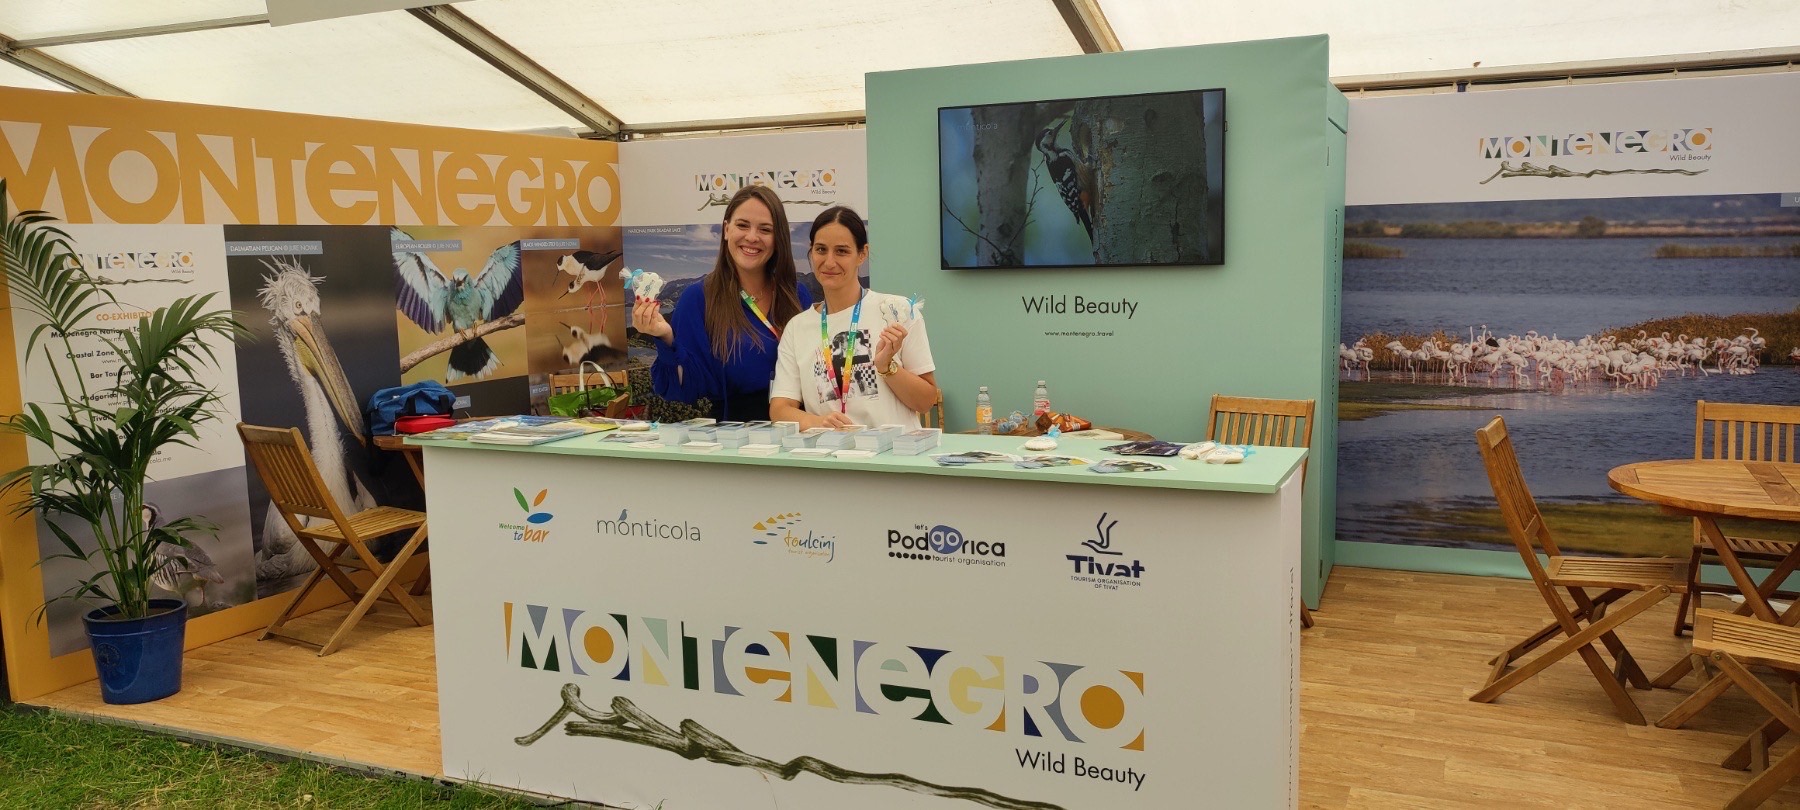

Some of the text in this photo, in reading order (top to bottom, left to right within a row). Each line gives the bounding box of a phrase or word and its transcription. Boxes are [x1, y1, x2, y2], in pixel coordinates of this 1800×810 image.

[1669, 152, 1712, 161] Wild Beauty
[1022, 294, 1139, 320] Wild Beauty
[96, 311, 155, 321] CO-EXHIBITO
[1044, 330, 1115, 338] www.montenegro.travel
[596, 518, 701, 542] monticola
[914, 523, 928, 531] let's
[513, 524, 550, 543] to bar
[932, 555, 1006, 567] tourist organisation
[1065, 554, 1146, 579] Tivat
[1070, 575, 1141, 587] TOURISM ORGANISATION
[1015, 748, 1146, 791] Wild Beauty
